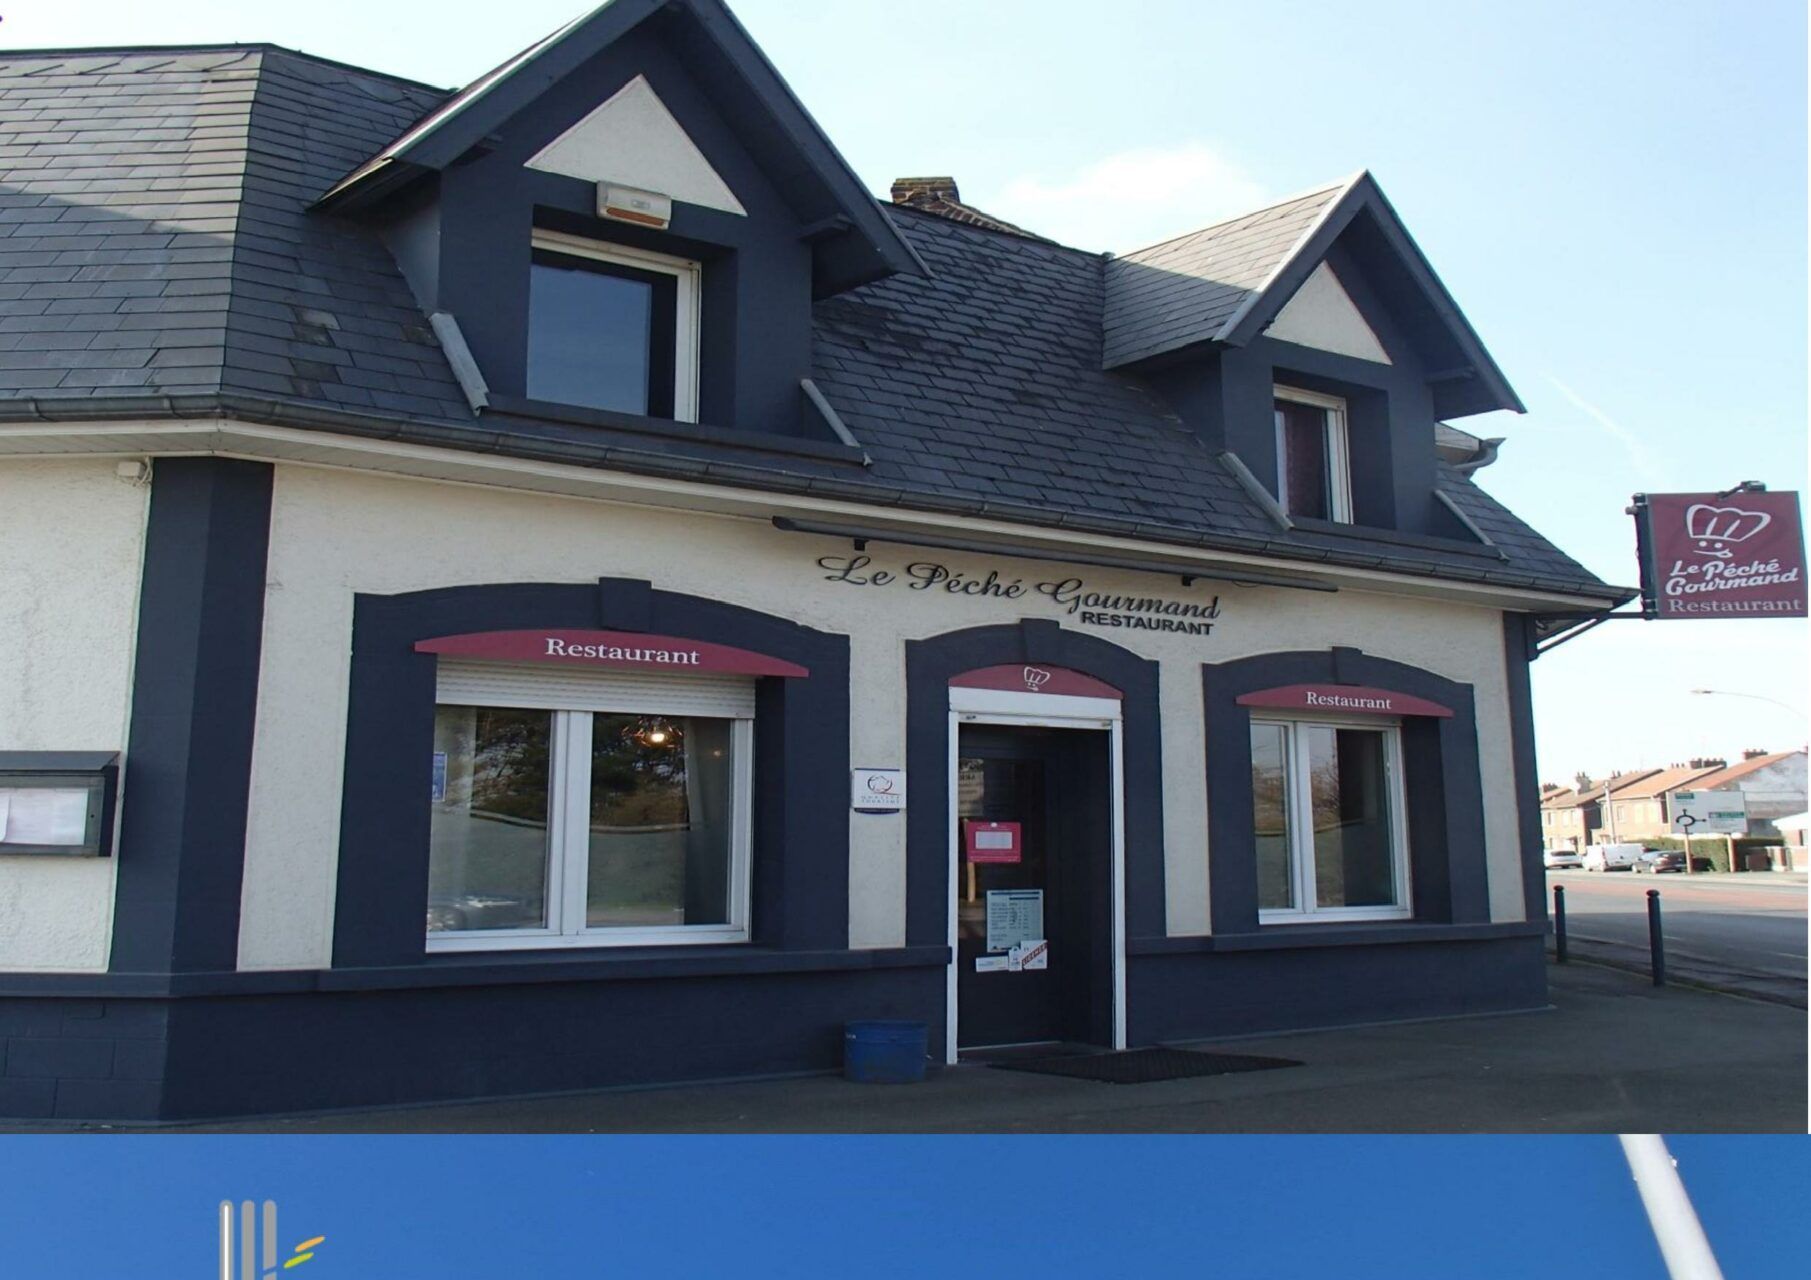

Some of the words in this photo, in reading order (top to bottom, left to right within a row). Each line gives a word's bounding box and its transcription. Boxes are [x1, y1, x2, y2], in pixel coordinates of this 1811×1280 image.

[1665, 567, 1799, 596] Gourmand
[1670, 559, 1700, 577] Le
[1701, 558, 1782, 580] Péché
[816, 555, 896, 587] Le
[906, 561, 1028, 600] Péché
[1034, 577, 1222, 619] Gourmand
[1668, 598, 1803, 613] Restaurant
[1080, 610, 1215, 636] RESTAURANT
[544, 637, 700, 665] Restaurant
[1305, 690, 1393, 710] Restaurant
